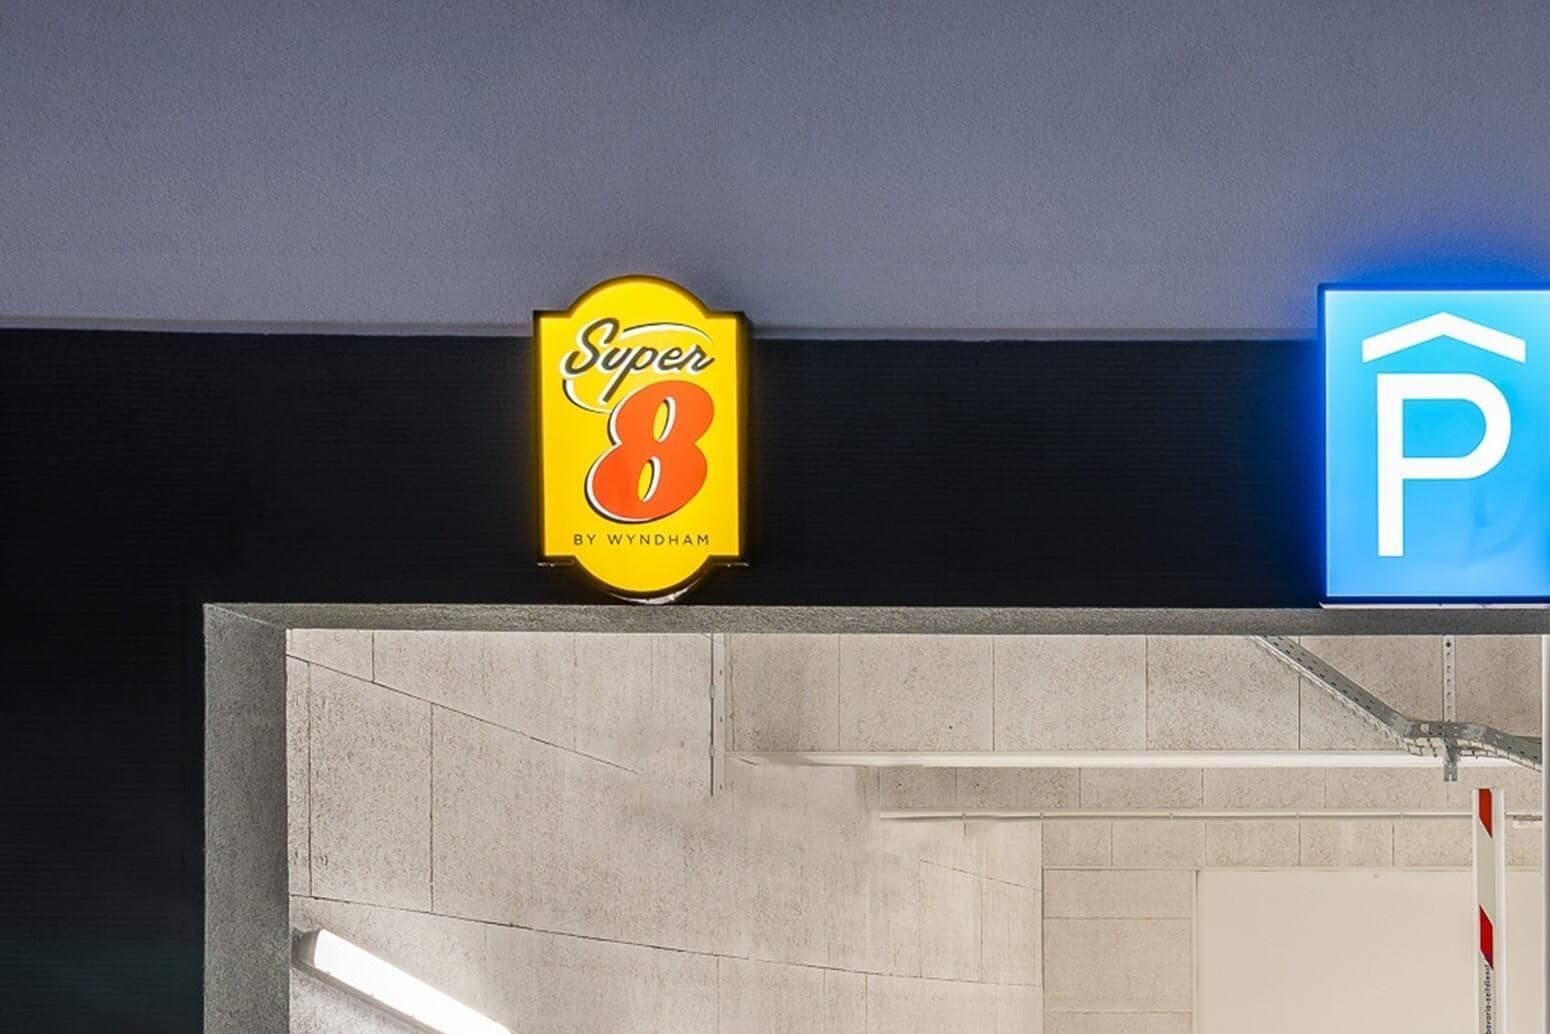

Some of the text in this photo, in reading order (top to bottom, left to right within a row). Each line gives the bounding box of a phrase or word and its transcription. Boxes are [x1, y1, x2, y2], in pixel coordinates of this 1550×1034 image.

[562, 317, 715, 403] Super
[584, 380, 715, 524] 8
[1377, 373, 1511, 557] P
[573, 534, 709, 545] BY WYNDHAM
